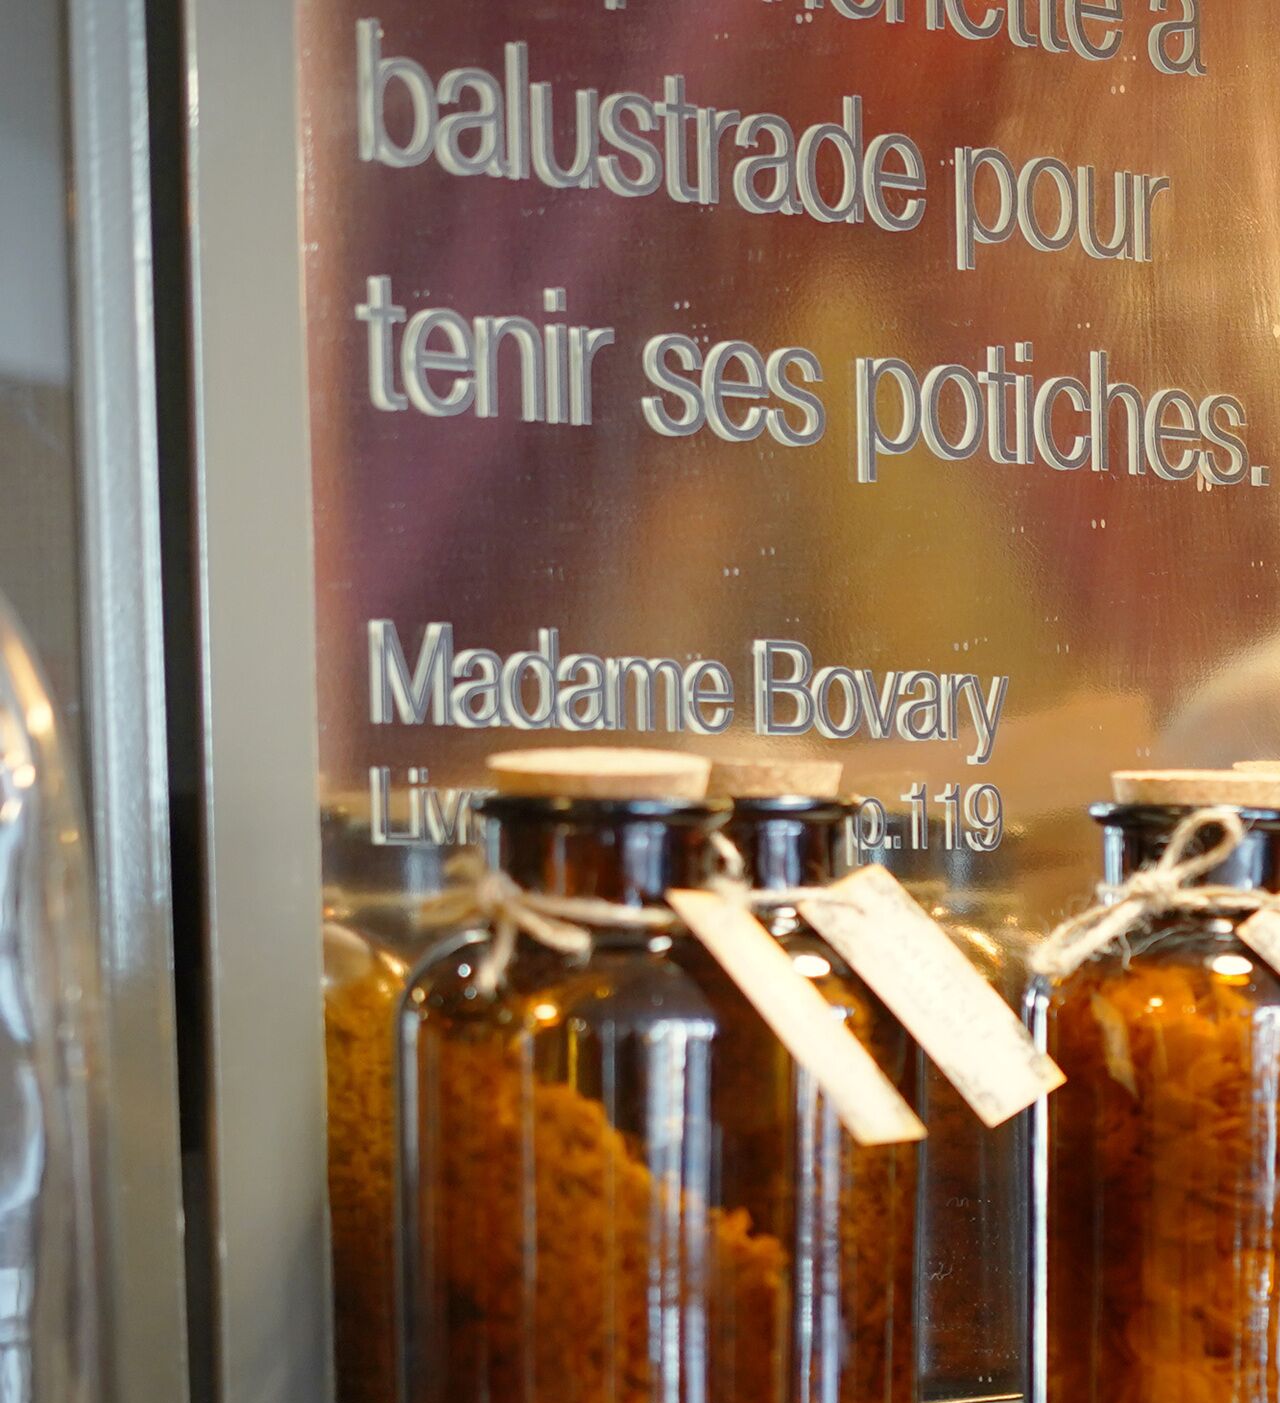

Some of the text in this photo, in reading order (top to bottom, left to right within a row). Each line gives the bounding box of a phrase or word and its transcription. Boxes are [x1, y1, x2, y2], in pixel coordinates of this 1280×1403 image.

[358, 19, 1169, 270] balustrade pour
[356, 275, 1269, 486] tenir ses potiches.
[368, 618, 1009, 765] Madame Bovary
[369, 765, 1003, 866] Livr p.119
